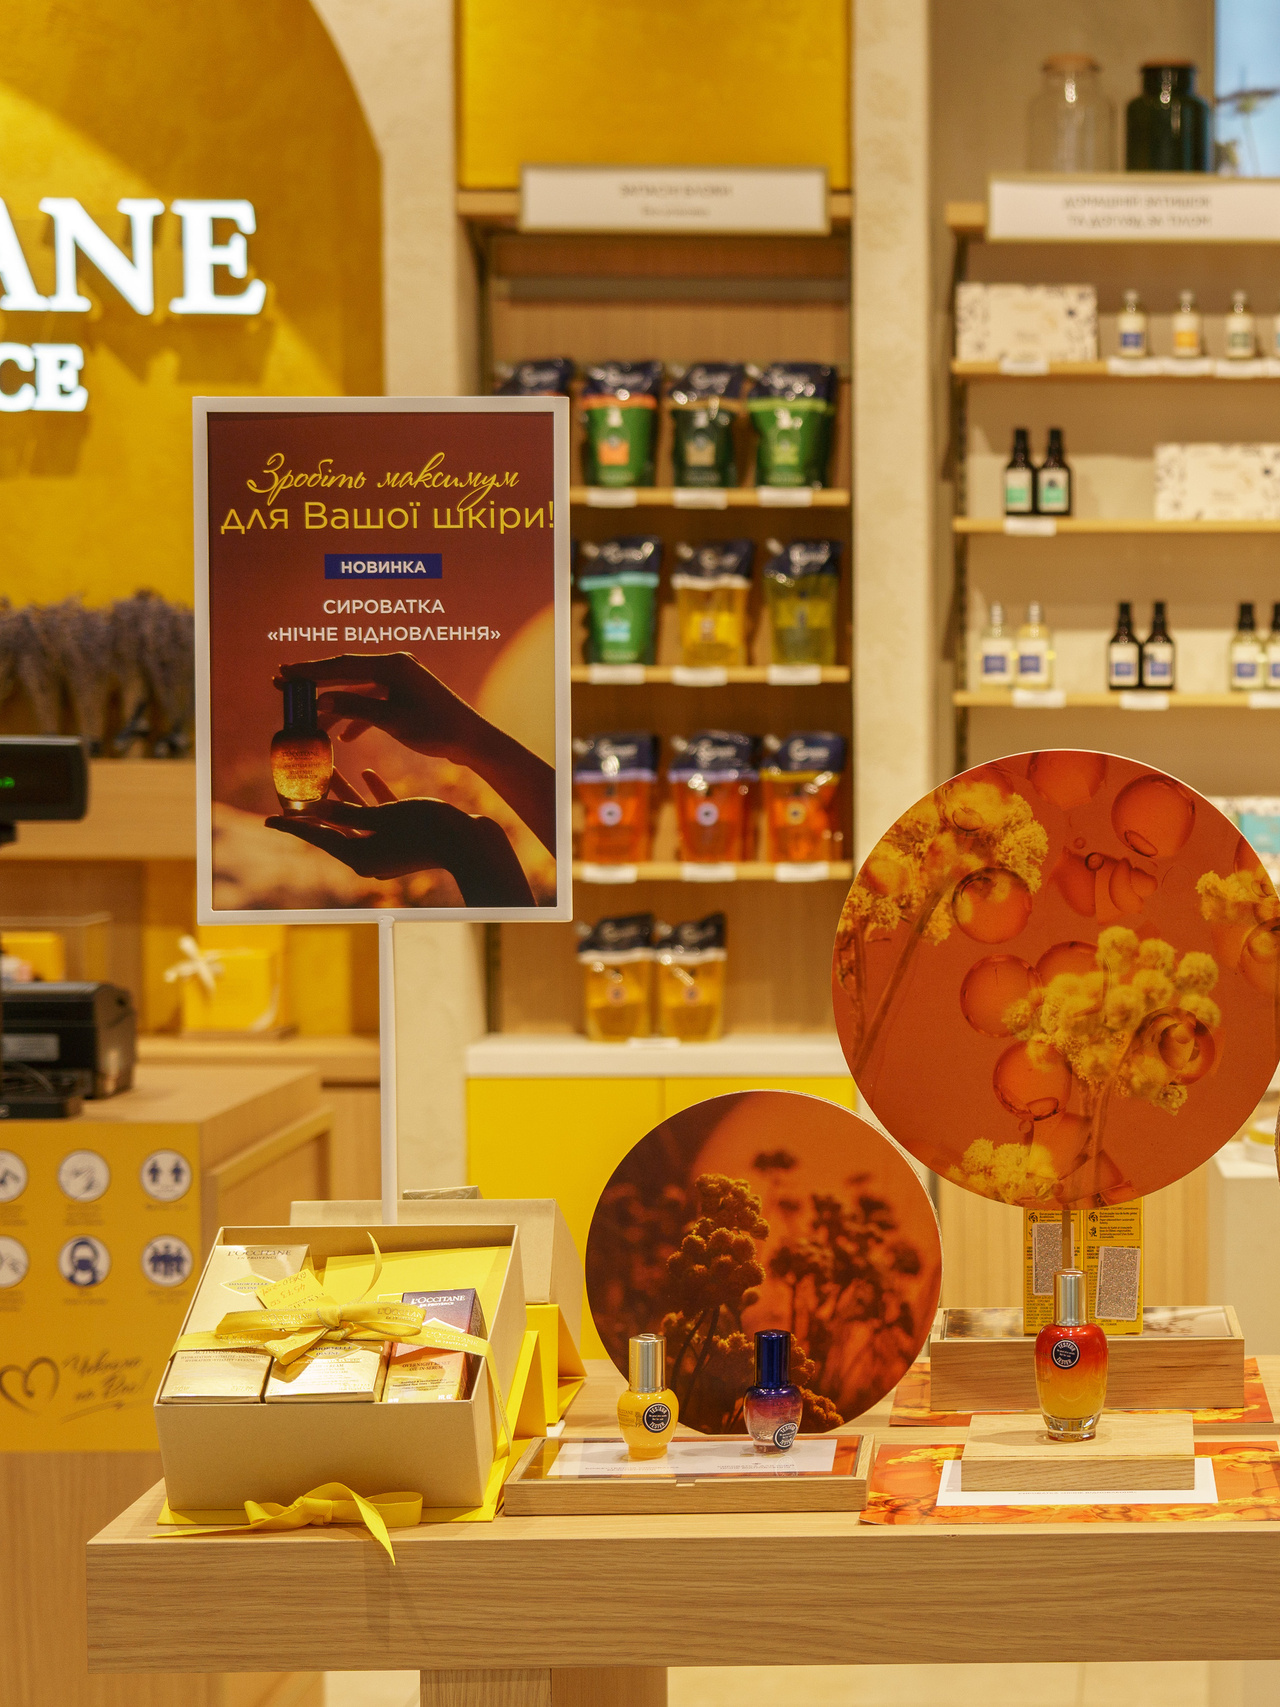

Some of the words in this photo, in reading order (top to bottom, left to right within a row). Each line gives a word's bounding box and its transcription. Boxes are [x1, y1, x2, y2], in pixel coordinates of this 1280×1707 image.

[0, 342, 89, 412] CE
[247, 452, 367, 506] Зробіть
[377, 452, 519, 512] максимум
[221, 507, 289, 535] для
[304, 501, 421, 530] Вашої
[434, 501, 554, 534] шкіри!
[341, 561, 426, 574] НОВИНКА
[323, 599, 445, 615] СИРОВАТКА
[267, 627, 338, 642] «НІЧНЕ
[345, 626, 501, 644] ВІДНОВЛЕННЯ»
[410, 1295, 466, 1305] L'OCCITANE
